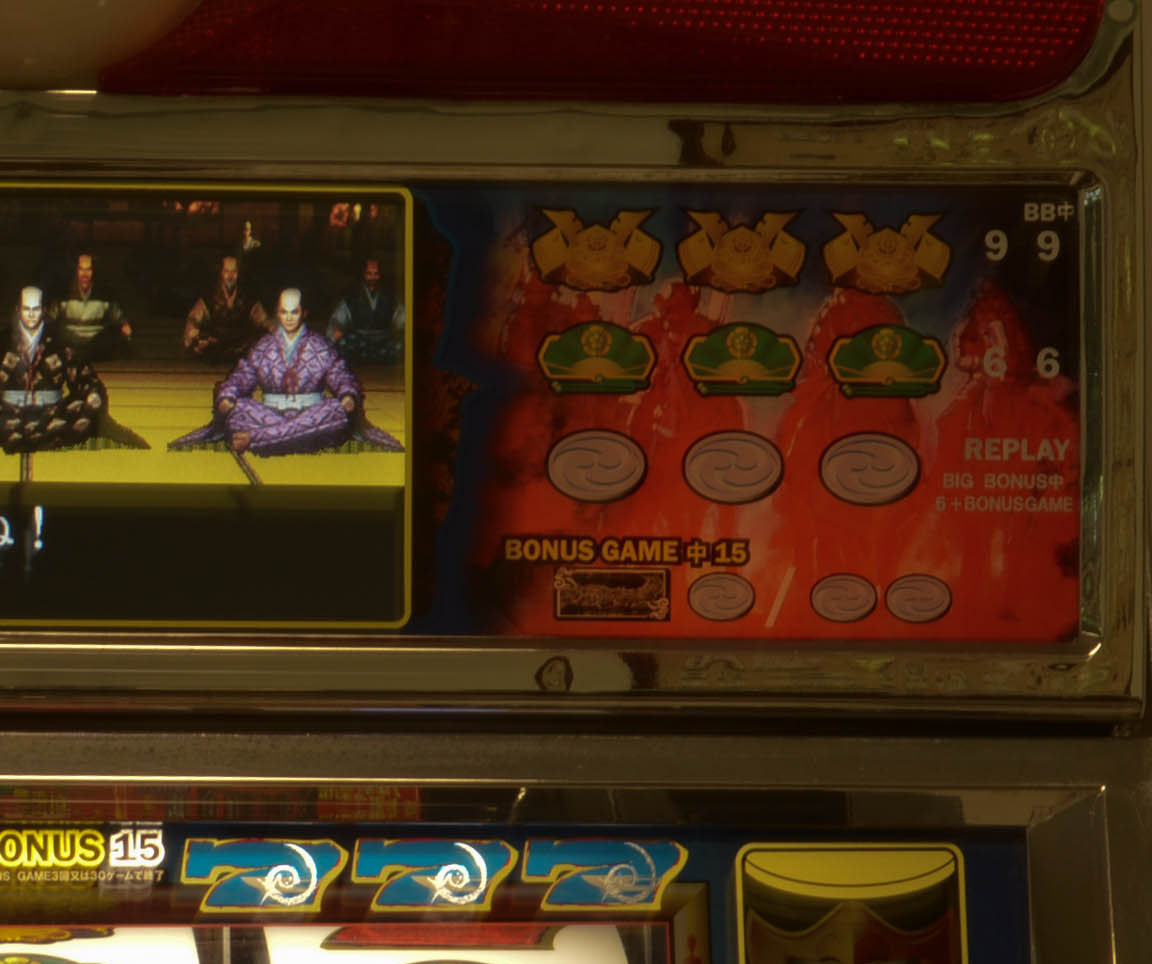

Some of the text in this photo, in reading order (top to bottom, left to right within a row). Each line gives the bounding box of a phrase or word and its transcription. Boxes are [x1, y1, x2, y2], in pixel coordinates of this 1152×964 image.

[984, 229, 1060, 261] 9 9
[983, 348, 1060, 379] 6 6
[964, 437, 1071, 461] REPLAY
[943, 473, 974, 489] BIG
[504, 539, 595, 562] BONUS
[601, 539, 679, 562] GAME
[714, 543, 747, 564] 15
[109, 829, 166, 868] 15
